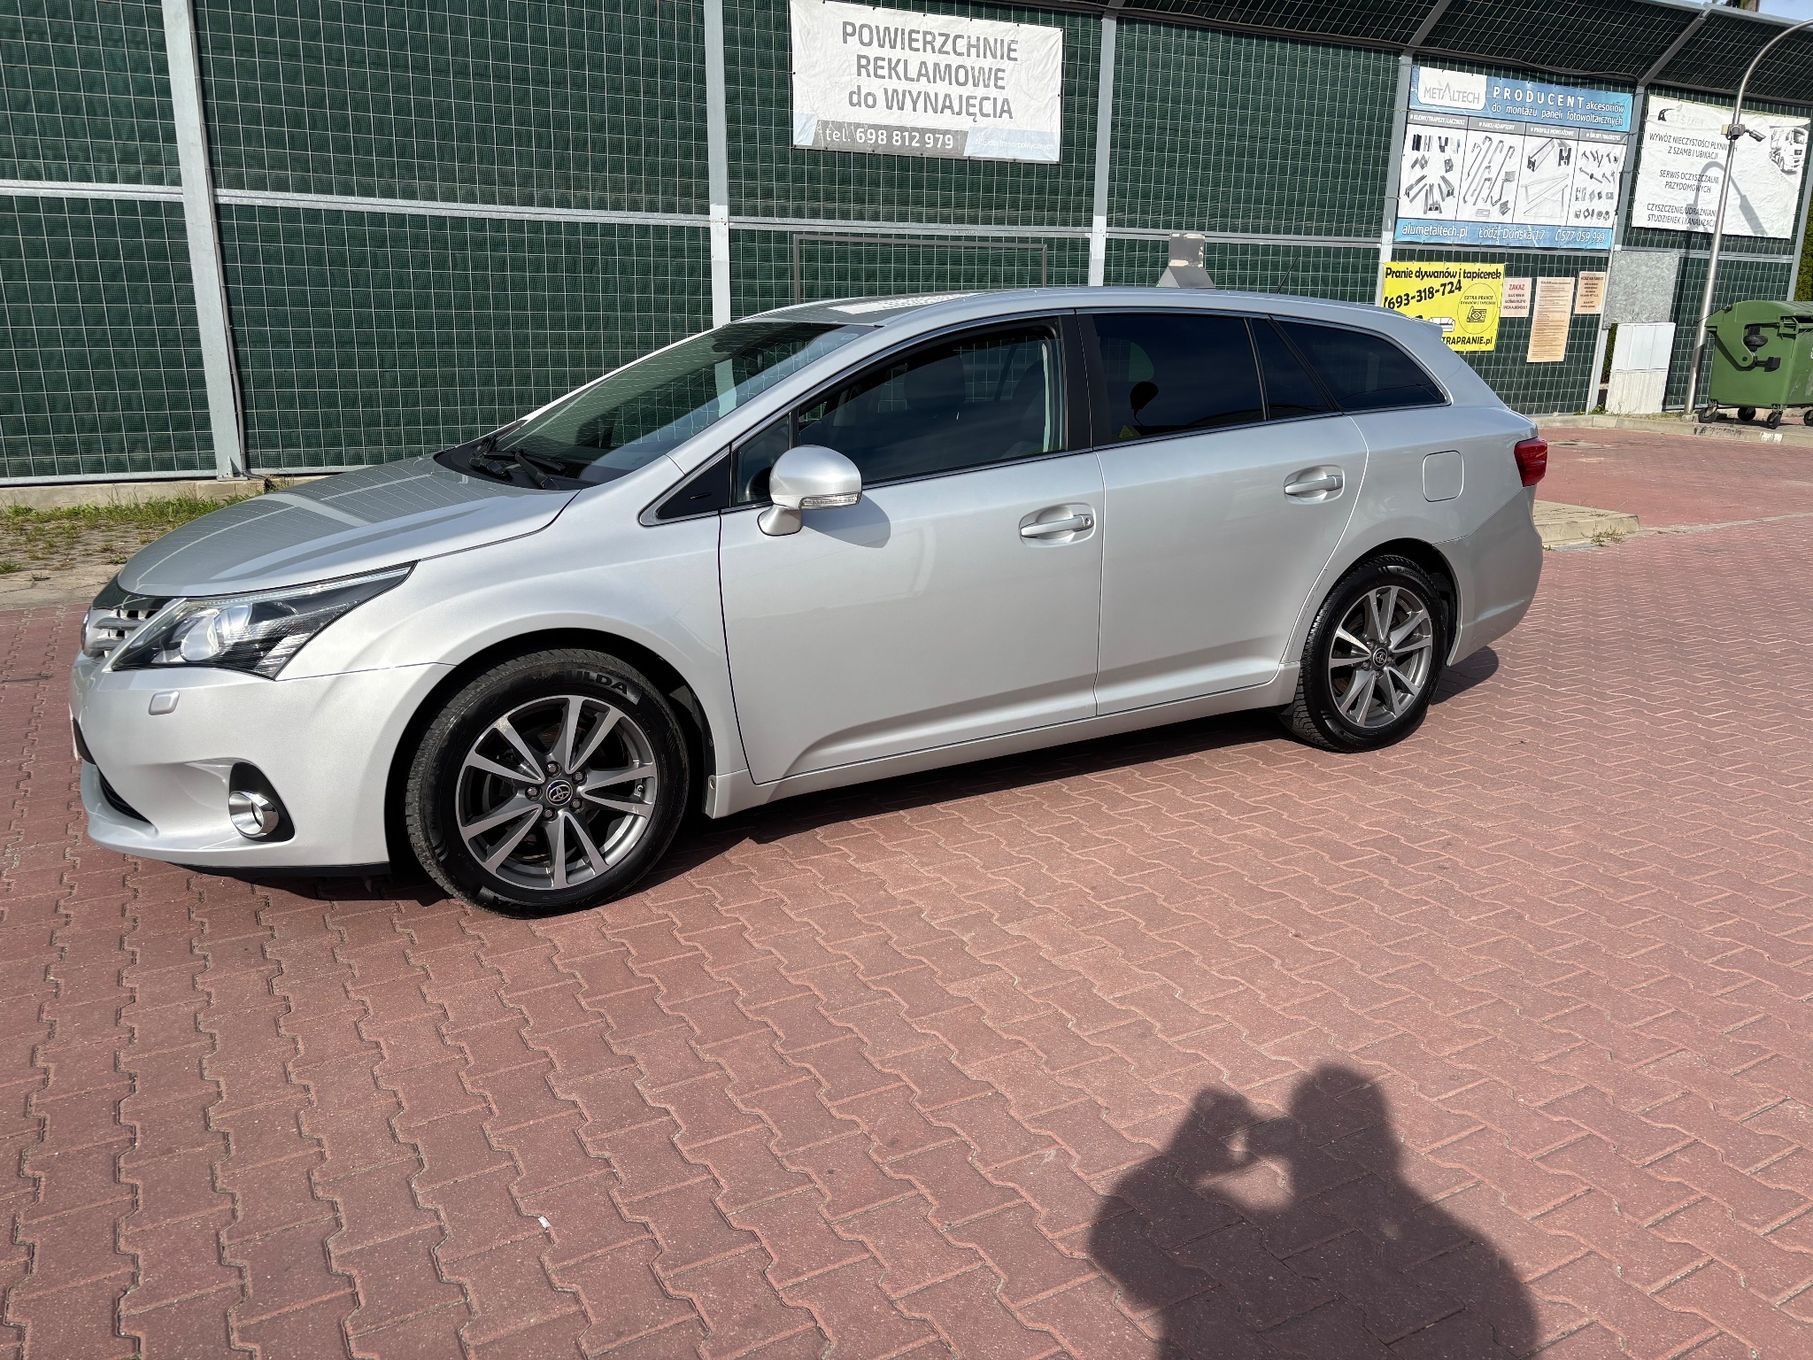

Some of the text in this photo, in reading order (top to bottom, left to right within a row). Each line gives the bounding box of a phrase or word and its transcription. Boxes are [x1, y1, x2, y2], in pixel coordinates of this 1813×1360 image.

[842, 21, 1018, 61] POWIERZCHNIE
[856, 54, 1005, 89] REKLAMOWE
[848, 85, 1013, 122] do WYNAJĘCIA
[1424, 82, 1480, 104] METALTECH
[1493, 87, 1624, 113] PRODUCENT akcesoriów
[1491, 102, 1623, 127] do montażu paneli fotowoltaicznych
[825, 127, 954, 149] tel. 698 812 979
[1673, 147, 1692, 156] SZAMB
[1660, 169, 1680, 179] SERWIS
[1402, 222, 1468, 239] alumetaltech.pl
[1560, 230, 1576, 242] 577
[1385, 267, 1413, 279] Pranie
[1415, 267, 1457, 280] dywanów
[1463, 268, 1501, 281] tapicerek
[1388, 279, 1462, 309] 693-318-724
[1442, 336, 1493, 346] TRAPRANIE.pl
